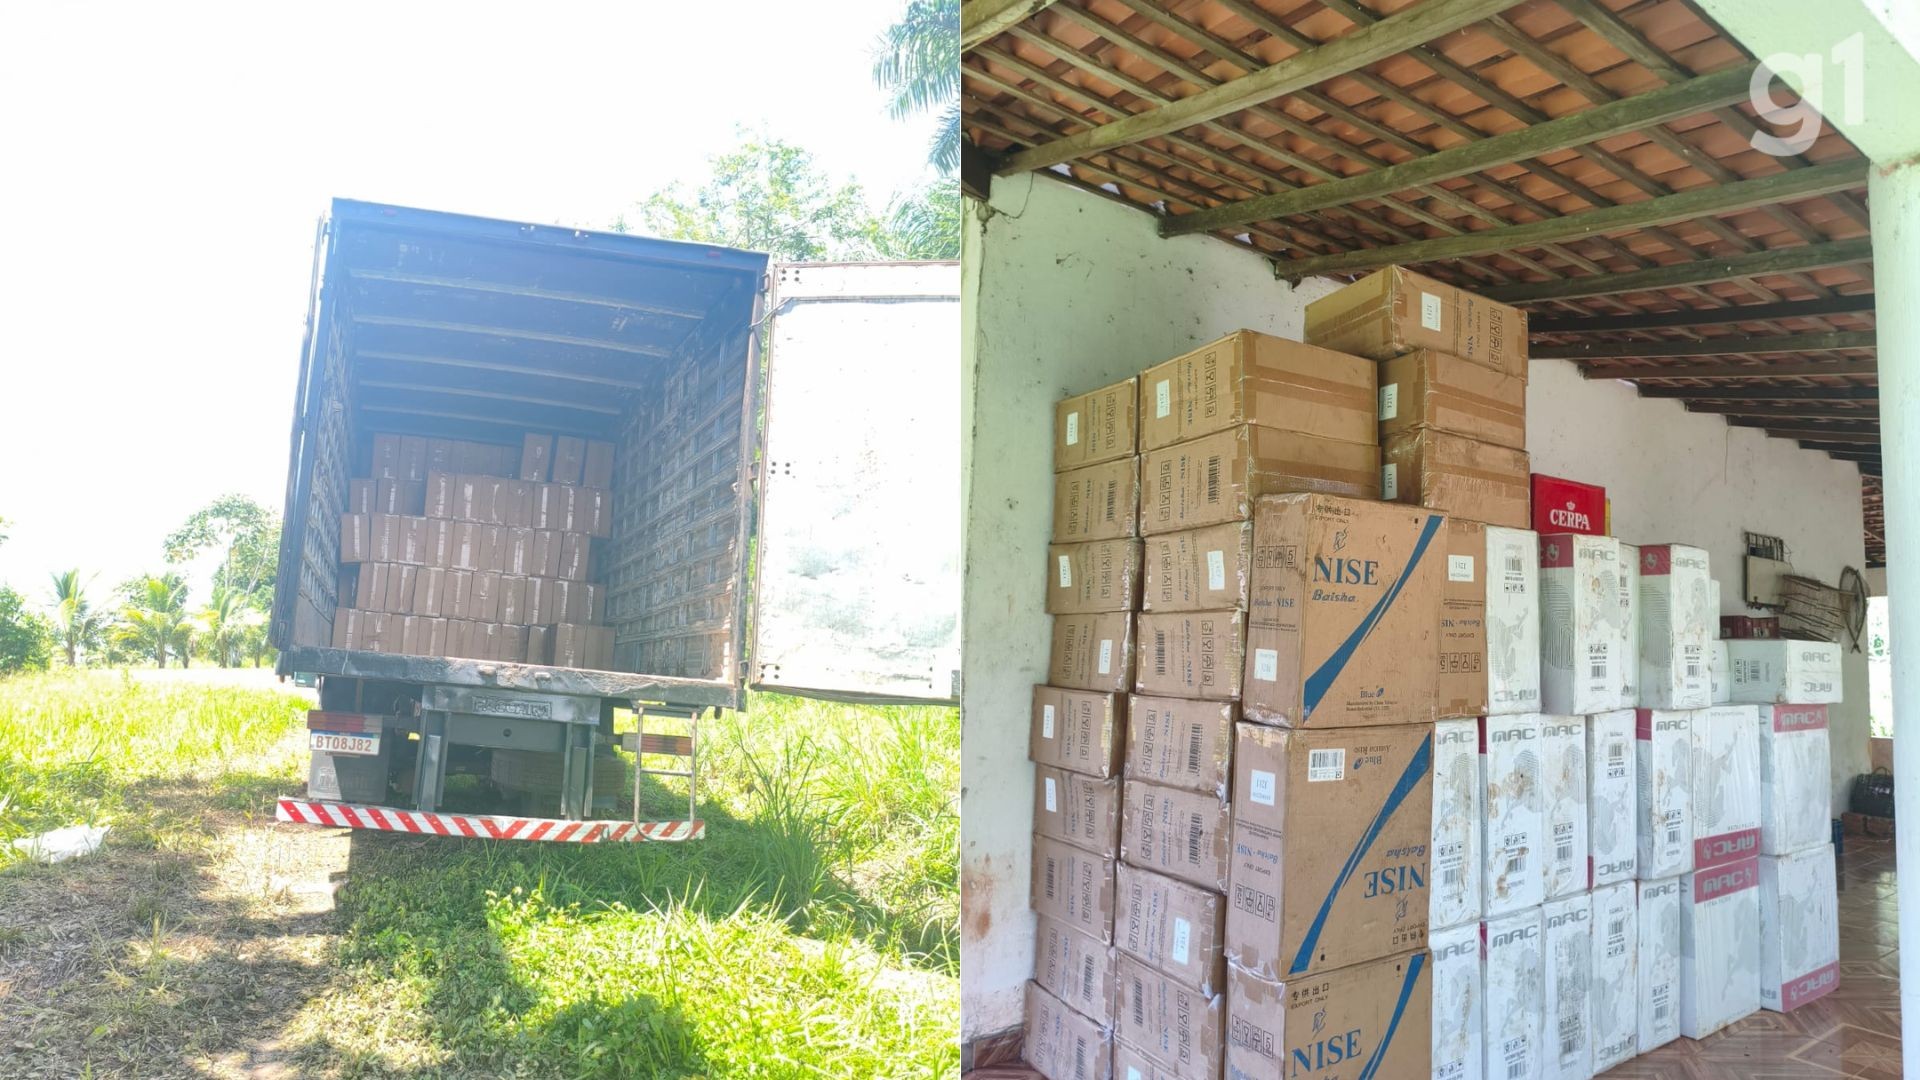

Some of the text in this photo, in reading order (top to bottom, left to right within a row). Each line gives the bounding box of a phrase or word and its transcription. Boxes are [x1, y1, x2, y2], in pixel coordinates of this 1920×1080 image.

[1549, 508, 1591, 530] CERPA
[1579, 548, 1616, 561] MAC
[1313, 556, 1379, 586] NISE
[1675, 557, 1707, 570] MAC
[1312, 589, 1356, 602] Baisha
[1801, 651, 1832, 663] MAC
[1803, 682, 1833, 693] MAC
[1655, 718, 1689, 732] MAC
[1782, 711, 1816, 726] MAC
[1492, 728, 1537, 743] MAC
[1542, 724, 1582, 738] MAC
[1386, 845, 1426, 858] Baisha
[1713, 835, 1755, 856] MAC
[1598, 859, 1635, 876] MAC
[1364, 862, 1426, 898] NISE
[1703, 871, 1744, 894] MAC
[1644, 882, 1677, 900] MAC
[1547, 908, 1588, 929] MAC
[1492, 924, 1539, 948] MAC
[1291, 983, 1330, 1001] 专供出口
[1291, 995, 1329, 1010] EXPORT ONLY
[1291, 1029, 1362, 1078] NISE
